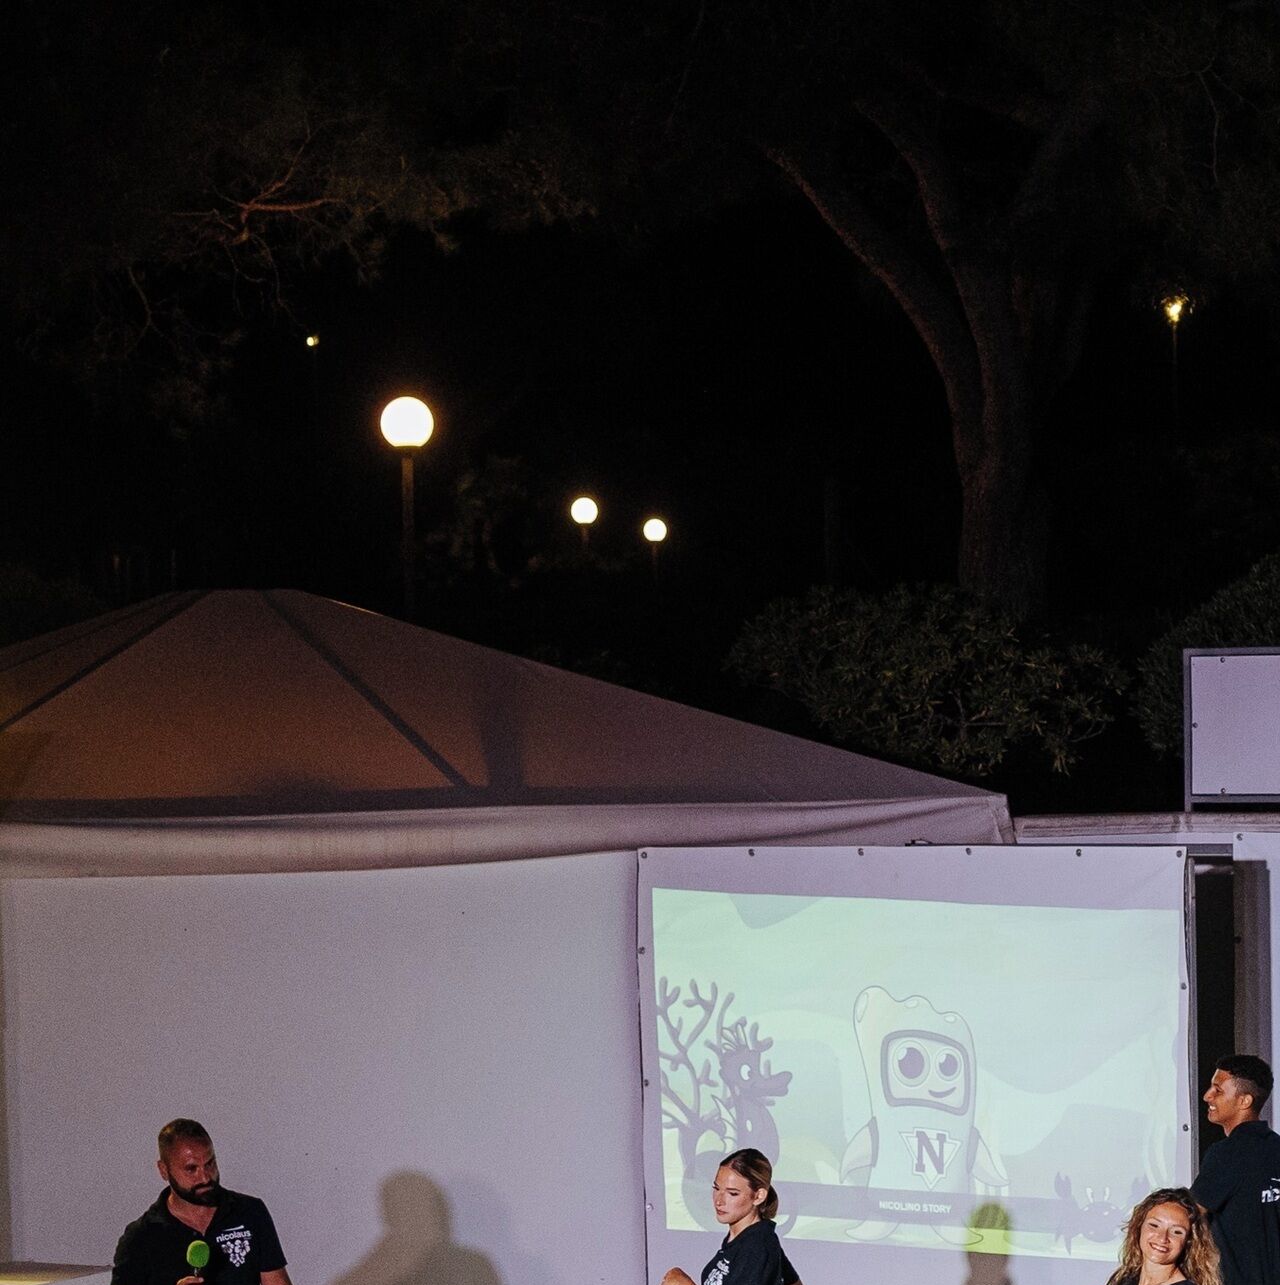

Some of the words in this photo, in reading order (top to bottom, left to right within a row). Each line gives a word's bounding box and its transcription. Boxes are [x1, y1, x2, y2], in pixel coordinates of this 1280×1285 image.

[914, 1130, 946, 1175] N
[879, 1200, 921, 1212] NICOLINO
[922, 1203, 952, 1213] STORY
